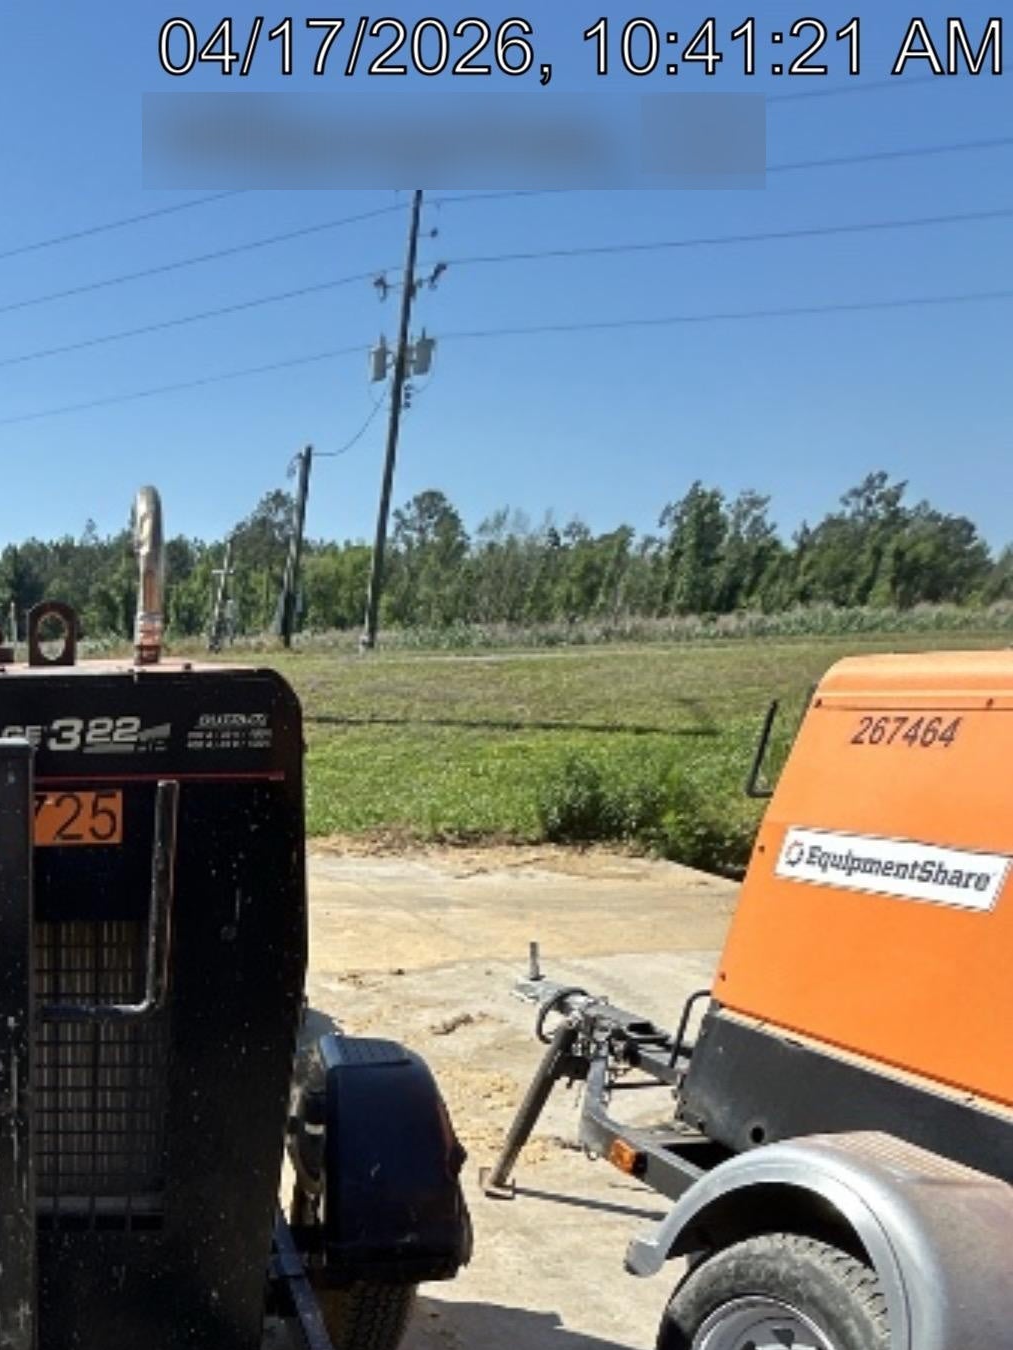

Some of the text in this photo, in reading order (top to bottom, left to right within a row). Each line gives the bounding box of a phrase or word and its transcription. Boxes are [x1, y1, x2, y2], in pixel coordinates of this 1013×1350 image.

[48, 716, 141, 751] 322
[850, 716, 964, 748] 267464
[806, 844, 991, 893] EquipmentShare
